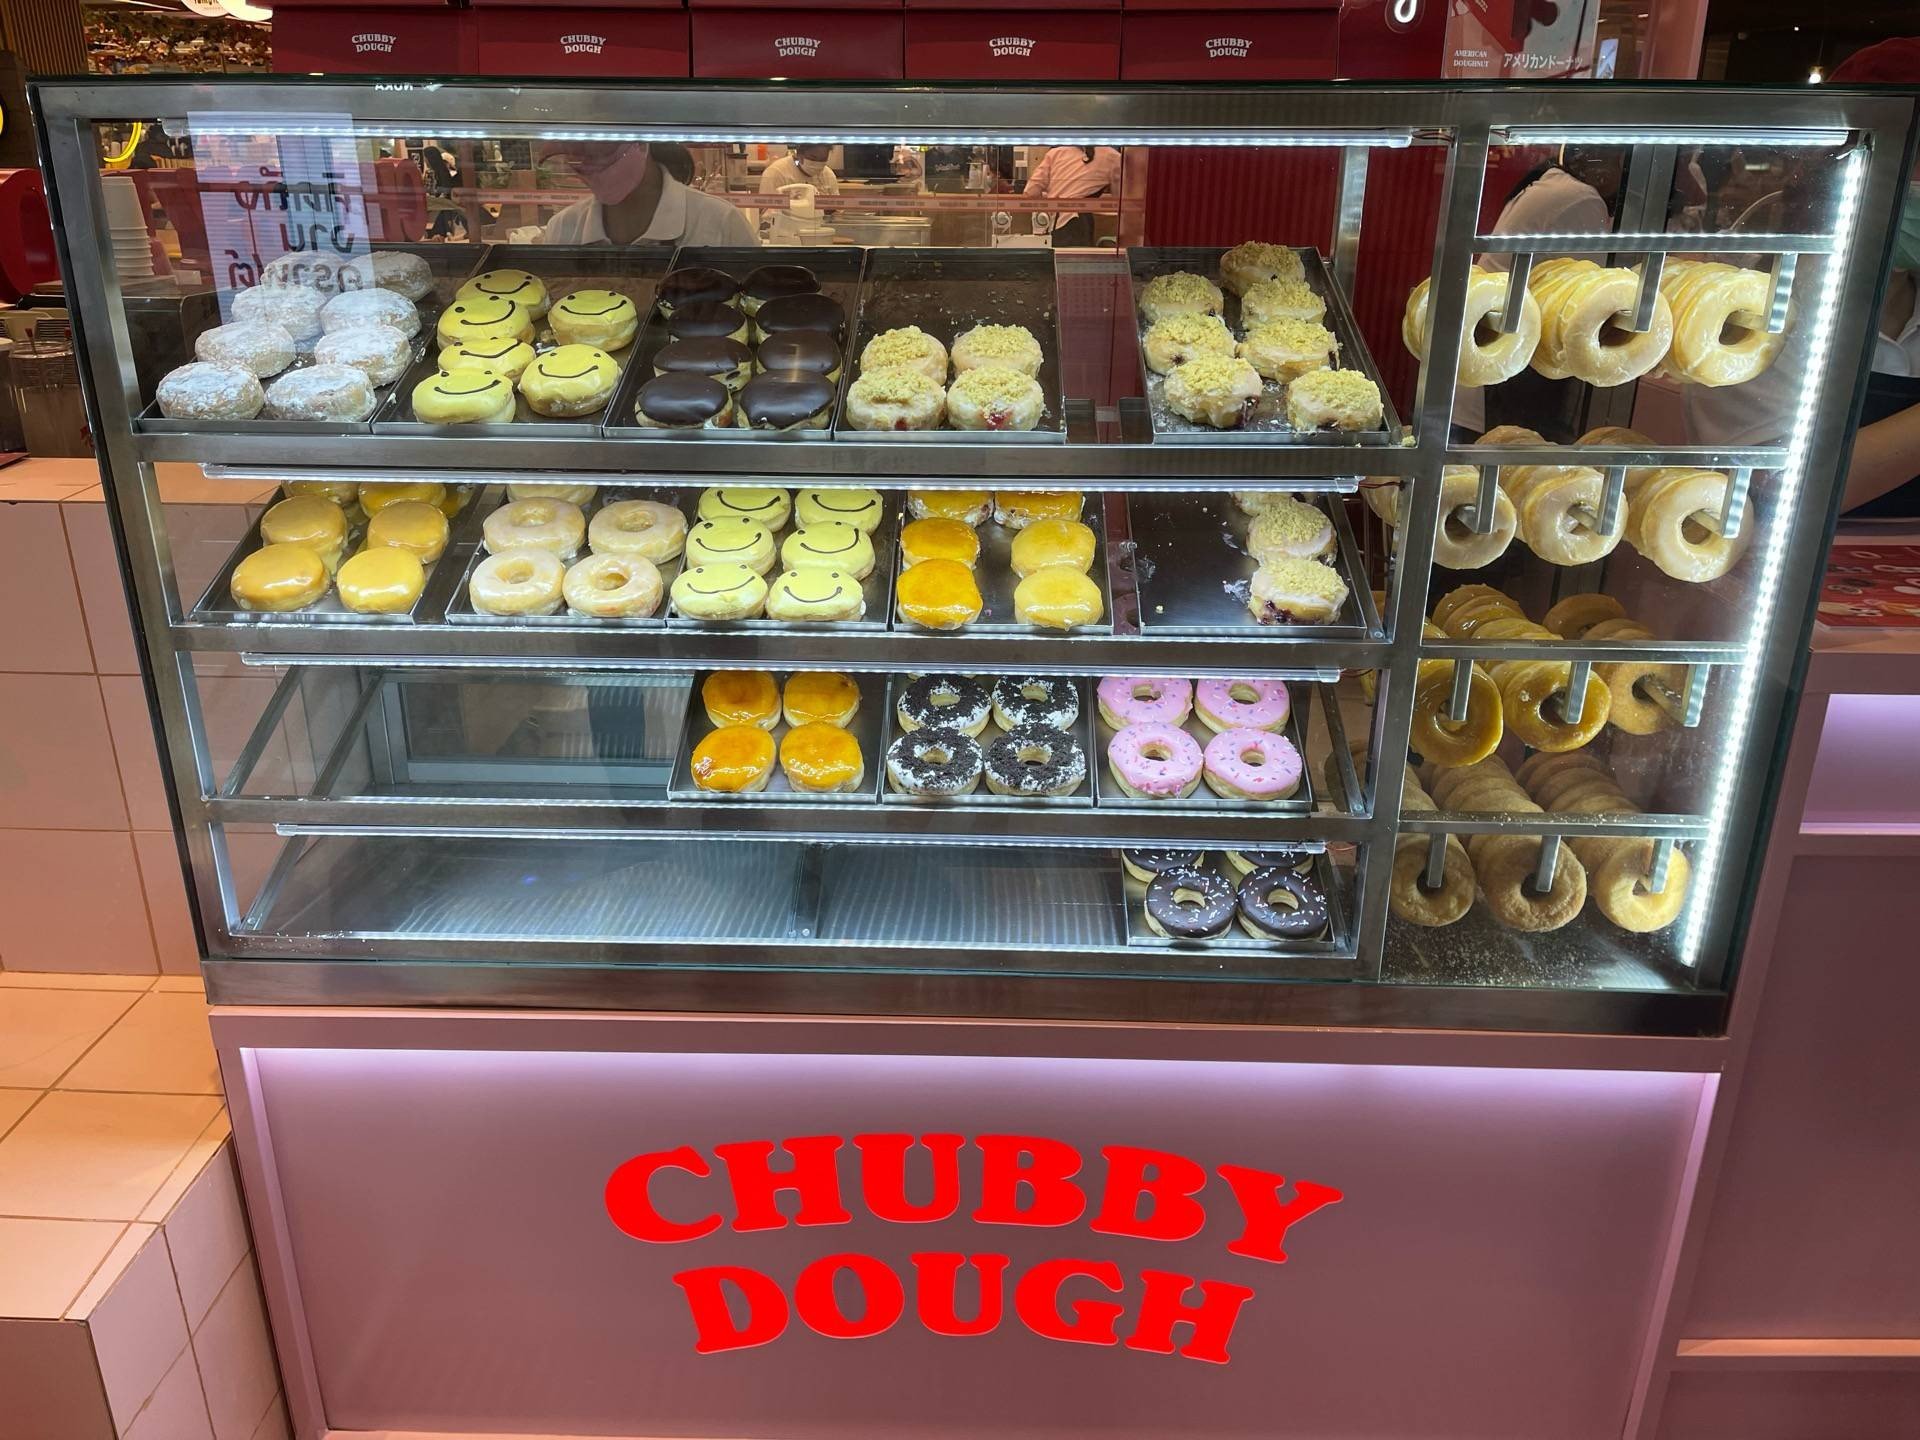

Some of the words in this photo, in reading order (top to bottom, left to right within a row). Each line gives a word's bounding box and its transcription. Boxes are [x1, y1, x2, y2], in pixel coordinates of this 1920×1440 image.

[352, 34, 397, 44] CHUBBY
[560, 34, 606, 45] CHUBBY
[775, 36, 821, 48] CHUBBY
[989, 37, 1036, 48] CHUBBY
[1205, 37, 1253, 49] CHUBBY
[356, 43, 392, 53] DOUGH
[564, 44, 602, 54] DOUGH
[779, 47, 817, 57] DOUGH
[993, 47, 1032, 57] DOUGH
[1209, 47, 1248, 58] DOUGH
[1455, 50, 1488, 58] AMERICAN
[1453, 60, 1489, 68] DOUGHNUT
[1503, 53, 1583, 70] アメリカンドーナツ
[605, 1133, 1344, 1263] CHUBBY
[672, 1252, 1256, 1364] DOUGH
